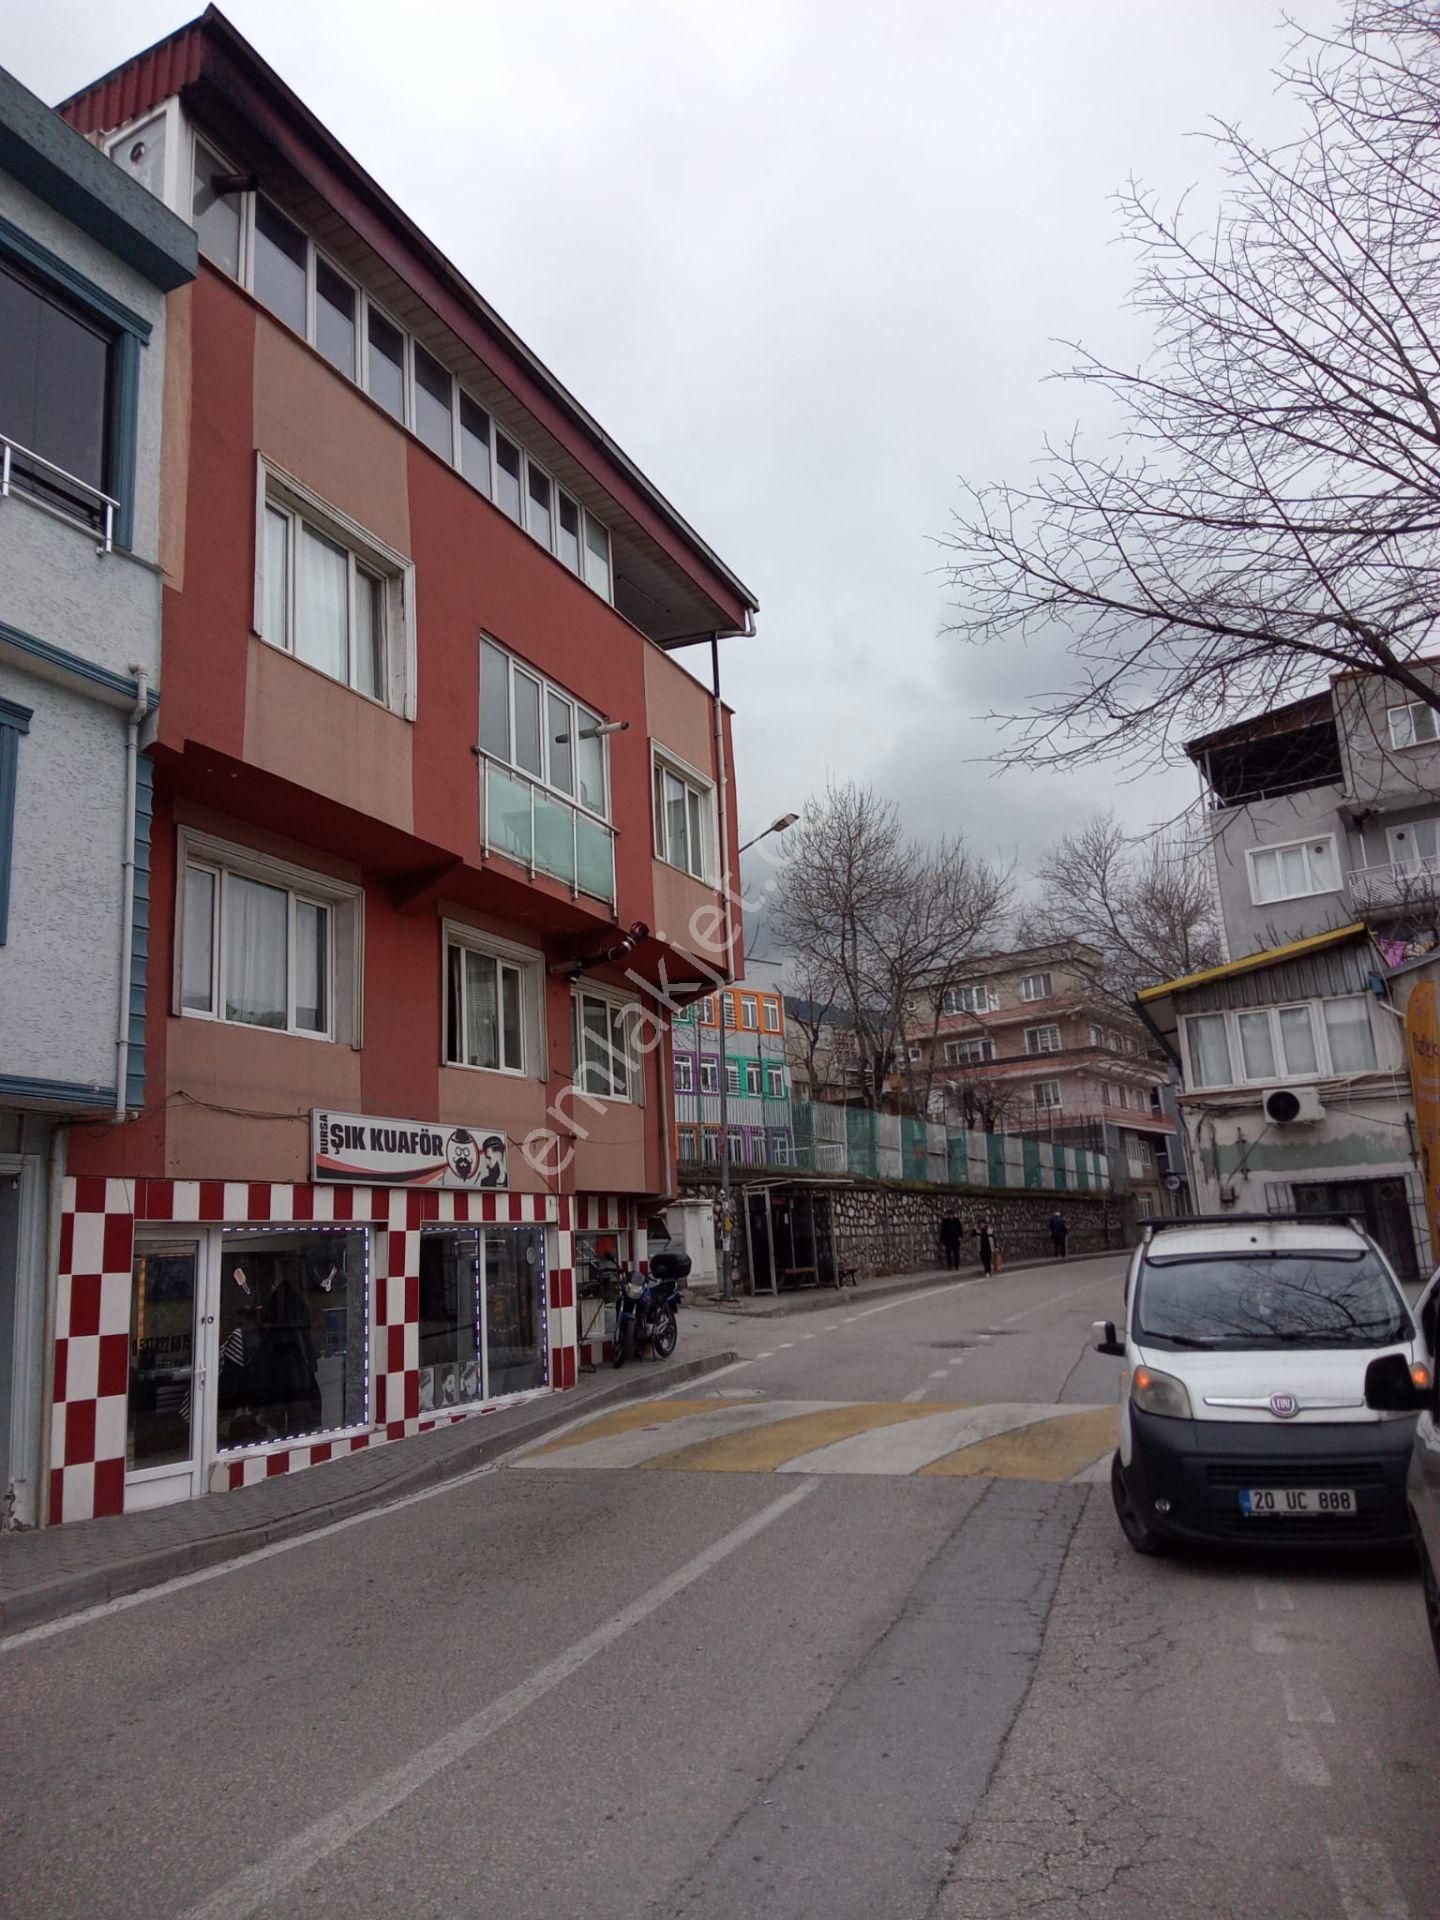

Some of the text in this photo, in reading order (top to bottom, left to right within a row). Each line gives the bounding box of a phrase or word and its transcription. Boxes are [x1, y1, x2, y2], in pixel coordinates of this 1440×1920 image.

[319, 1114, 329, 1155] BURSA
[330, 1123, 444, 1157] ŞIK KUAFÖR
[1253, 1491, 1351, 1511] 20 UC 888
